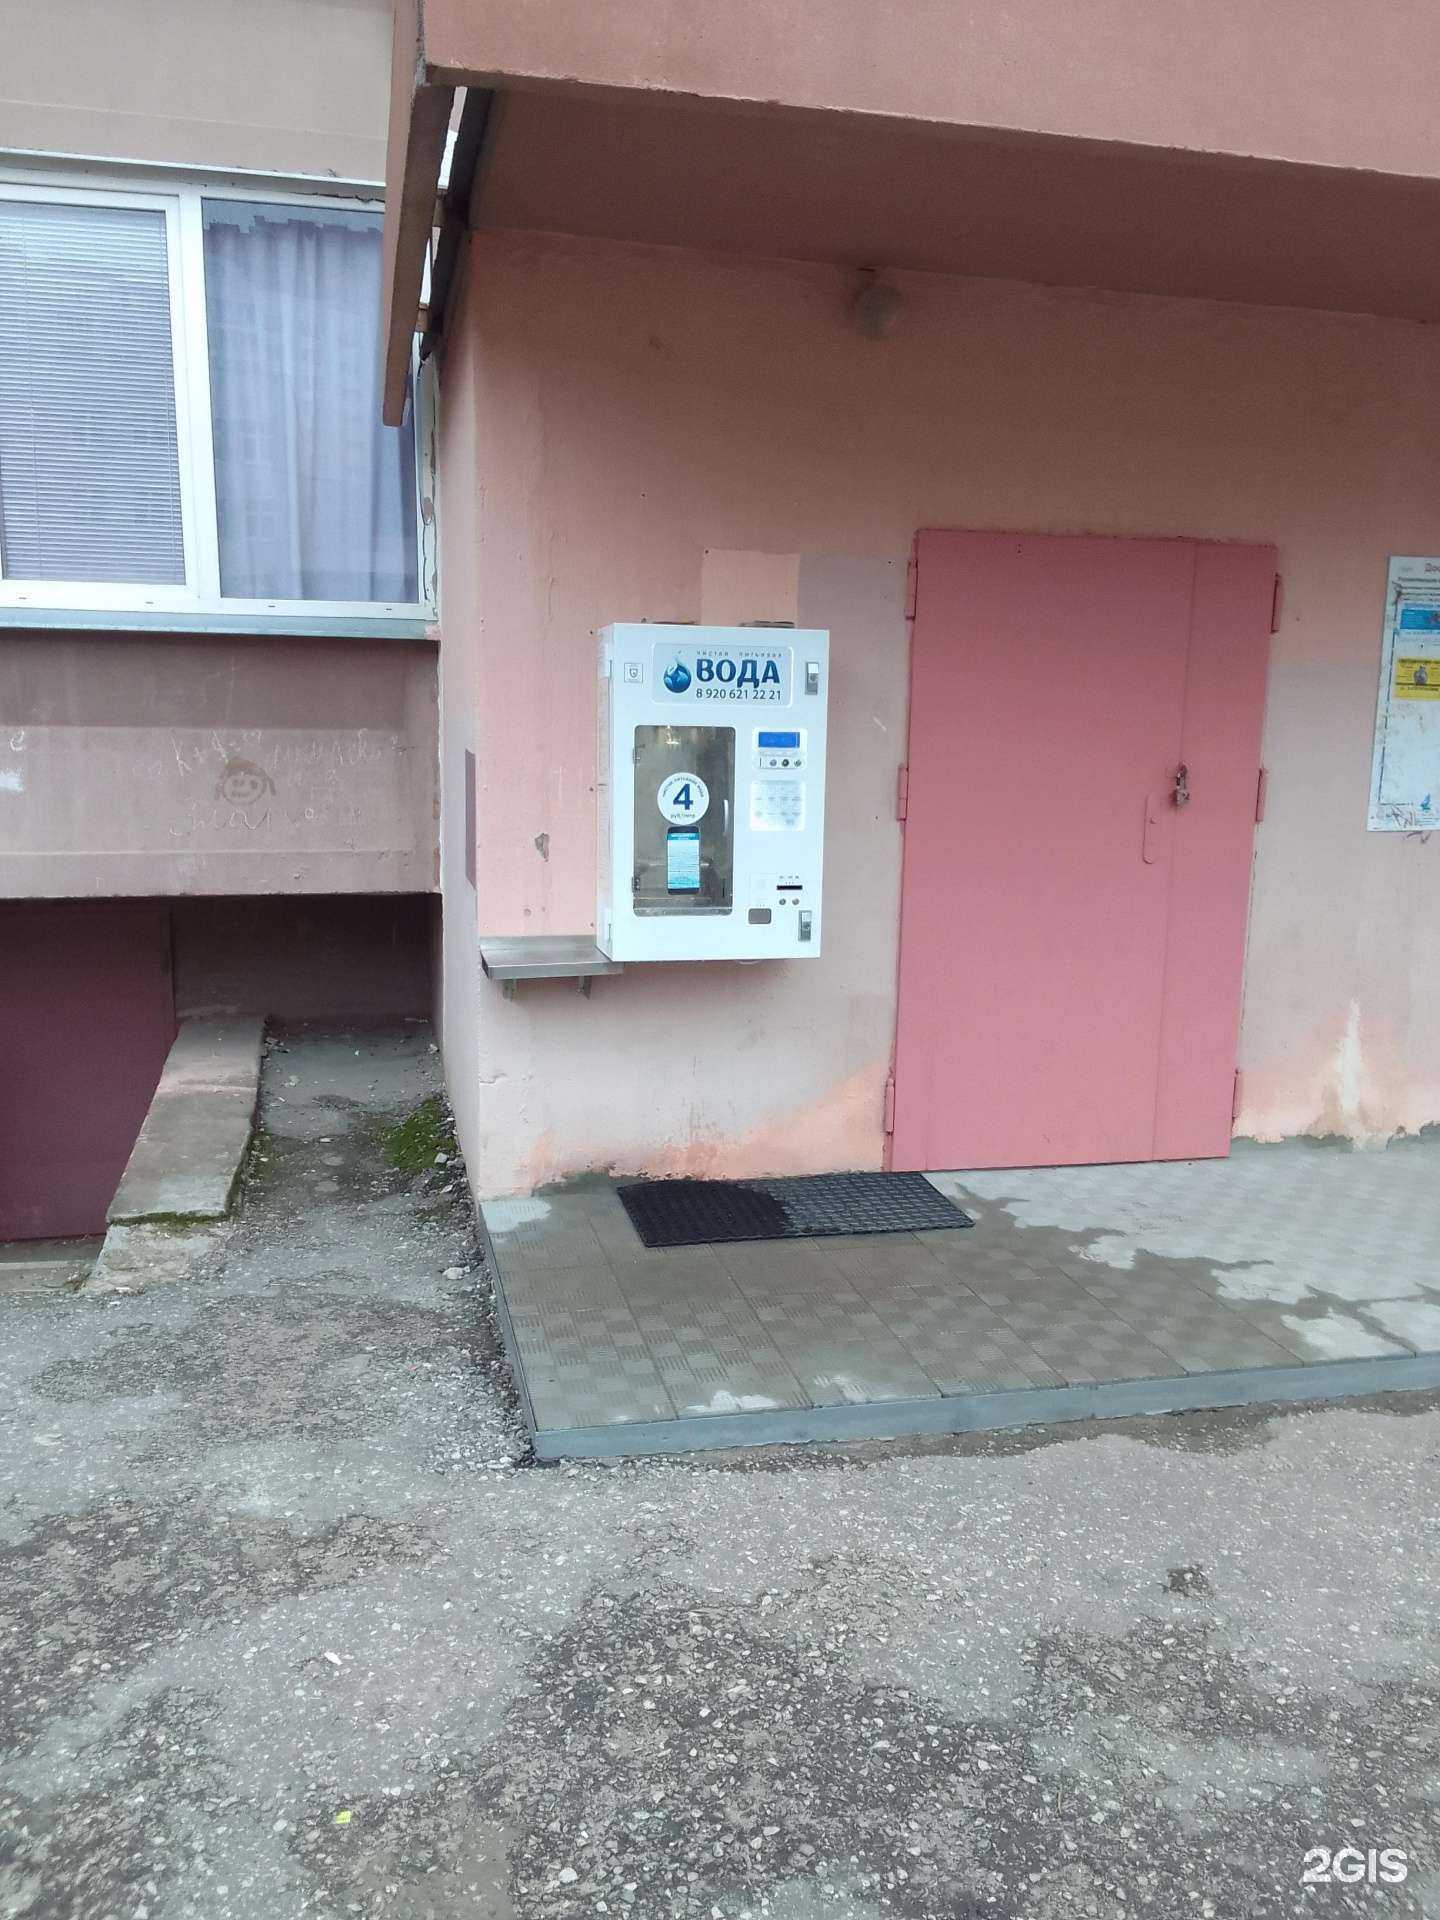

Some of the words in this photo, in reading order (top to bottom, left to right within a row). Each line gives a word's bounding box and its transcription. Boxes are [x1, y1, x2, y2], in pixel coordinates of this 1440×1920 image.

[696, 659, 780, 688] ВОДА
[696, 688, 703, 699] 8
[705, 688, 727, 699] 920
[729, 689, 748, 700] 621
[752, 689, 766, 700] 22
[769, 690, 781, 700] 21
[673, 783, 694, 810] 4
